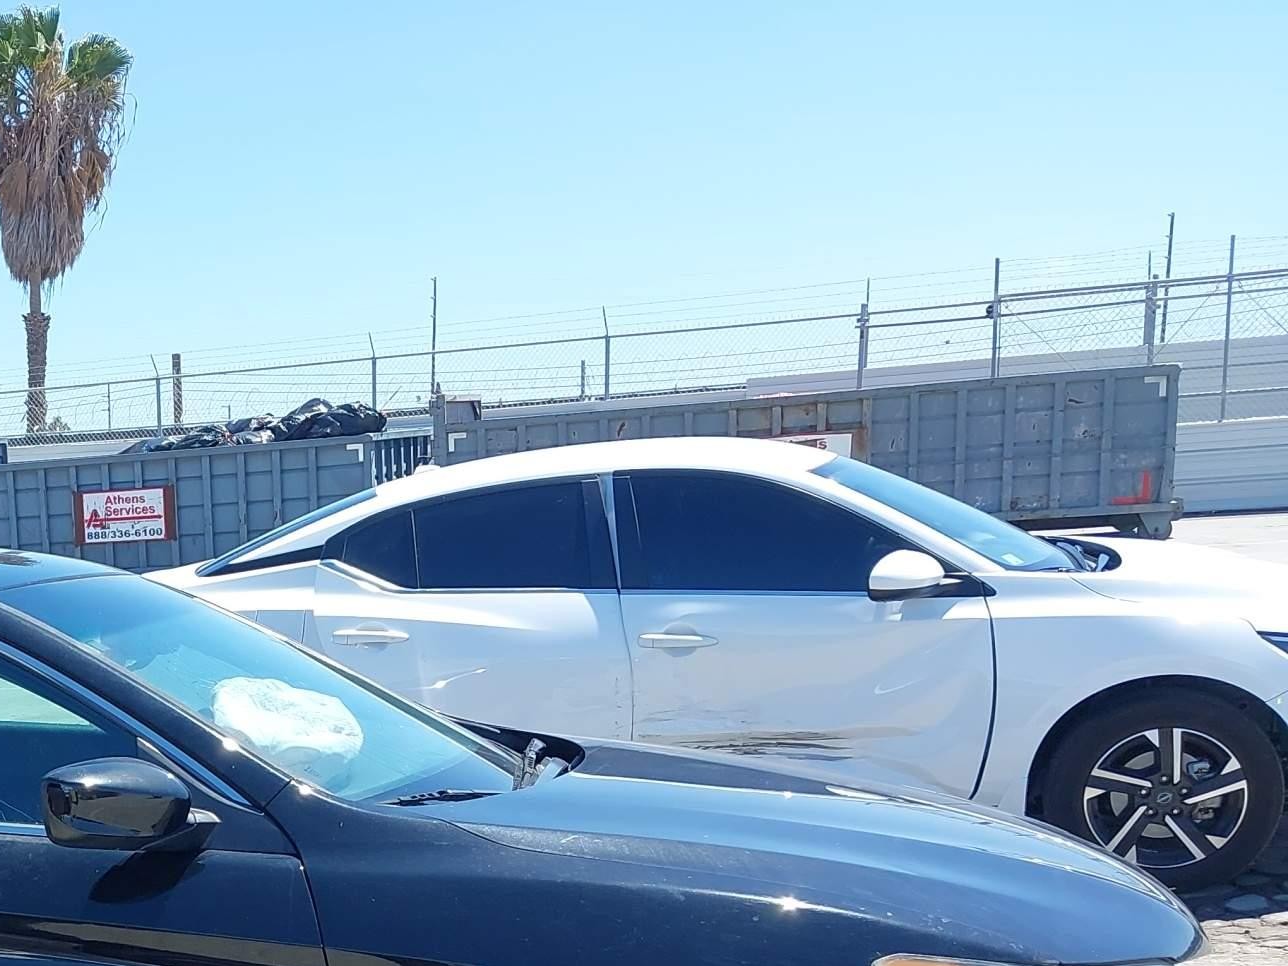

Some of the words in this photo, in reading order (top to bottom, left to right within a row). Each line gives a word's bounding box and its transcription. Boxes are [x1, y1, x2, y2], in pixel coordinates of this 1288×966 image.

[105, 495, 145, 505] Athens
[105, 505, 155, 516] Services
[87, 528, 162, 540] 888/336-6100
